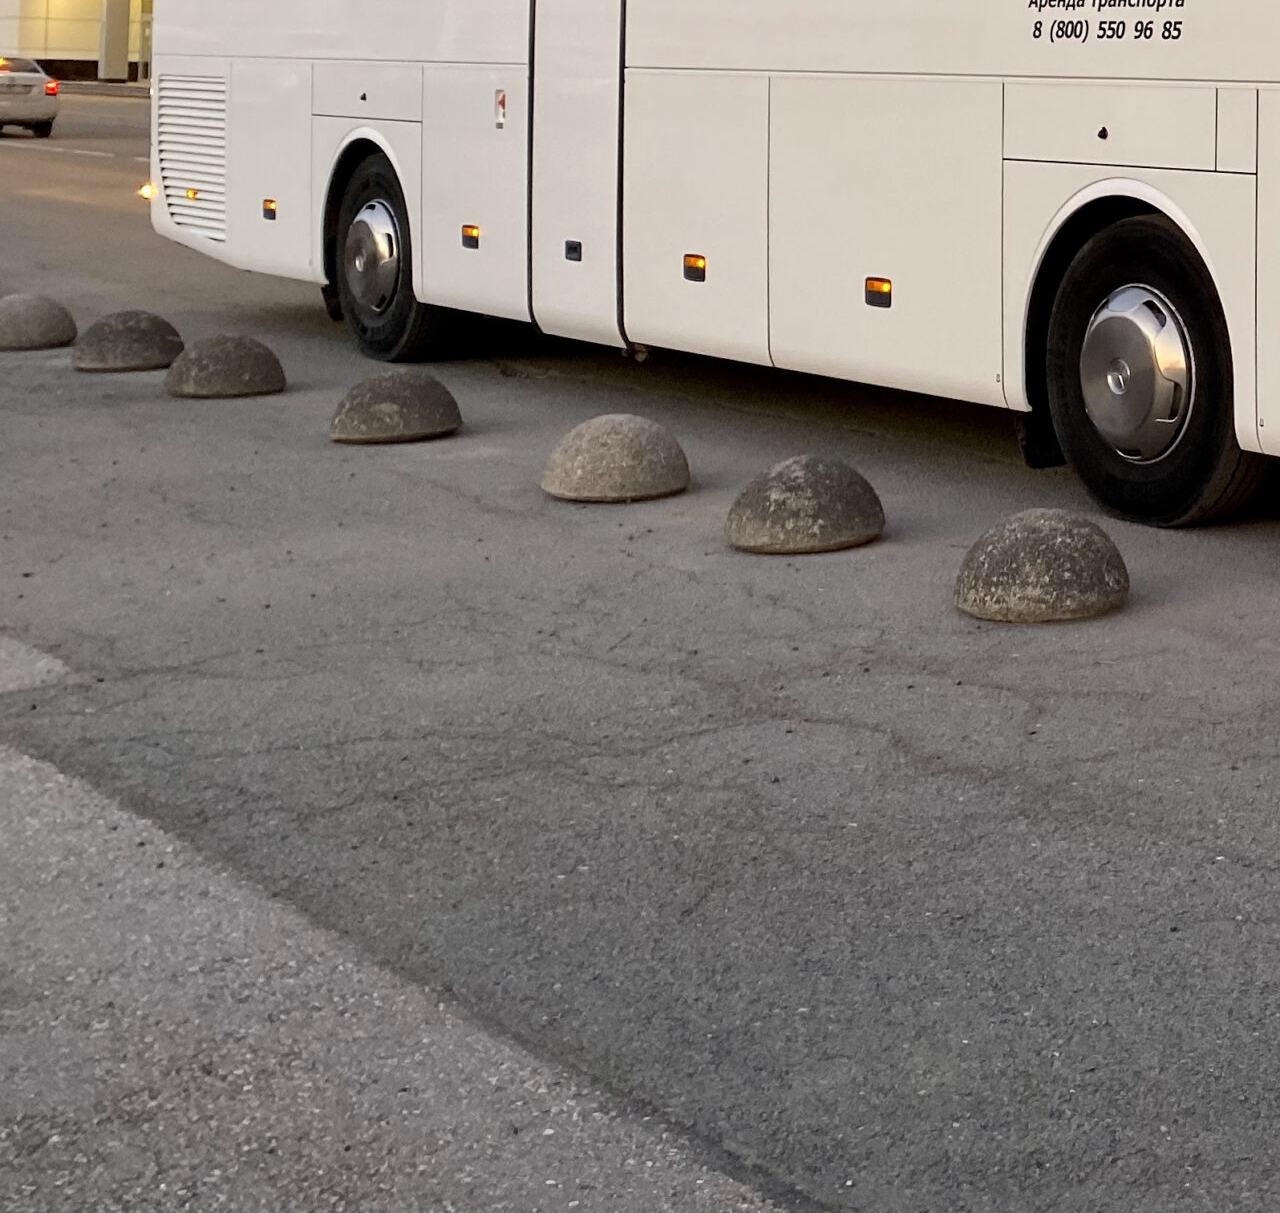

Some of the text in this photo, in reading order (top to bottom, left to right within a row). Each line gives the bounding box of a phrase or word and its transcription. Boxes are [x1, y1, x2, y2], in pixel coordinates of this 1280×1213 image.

[1032, 19, 1183, 43] 8 (800) 550 96 85
